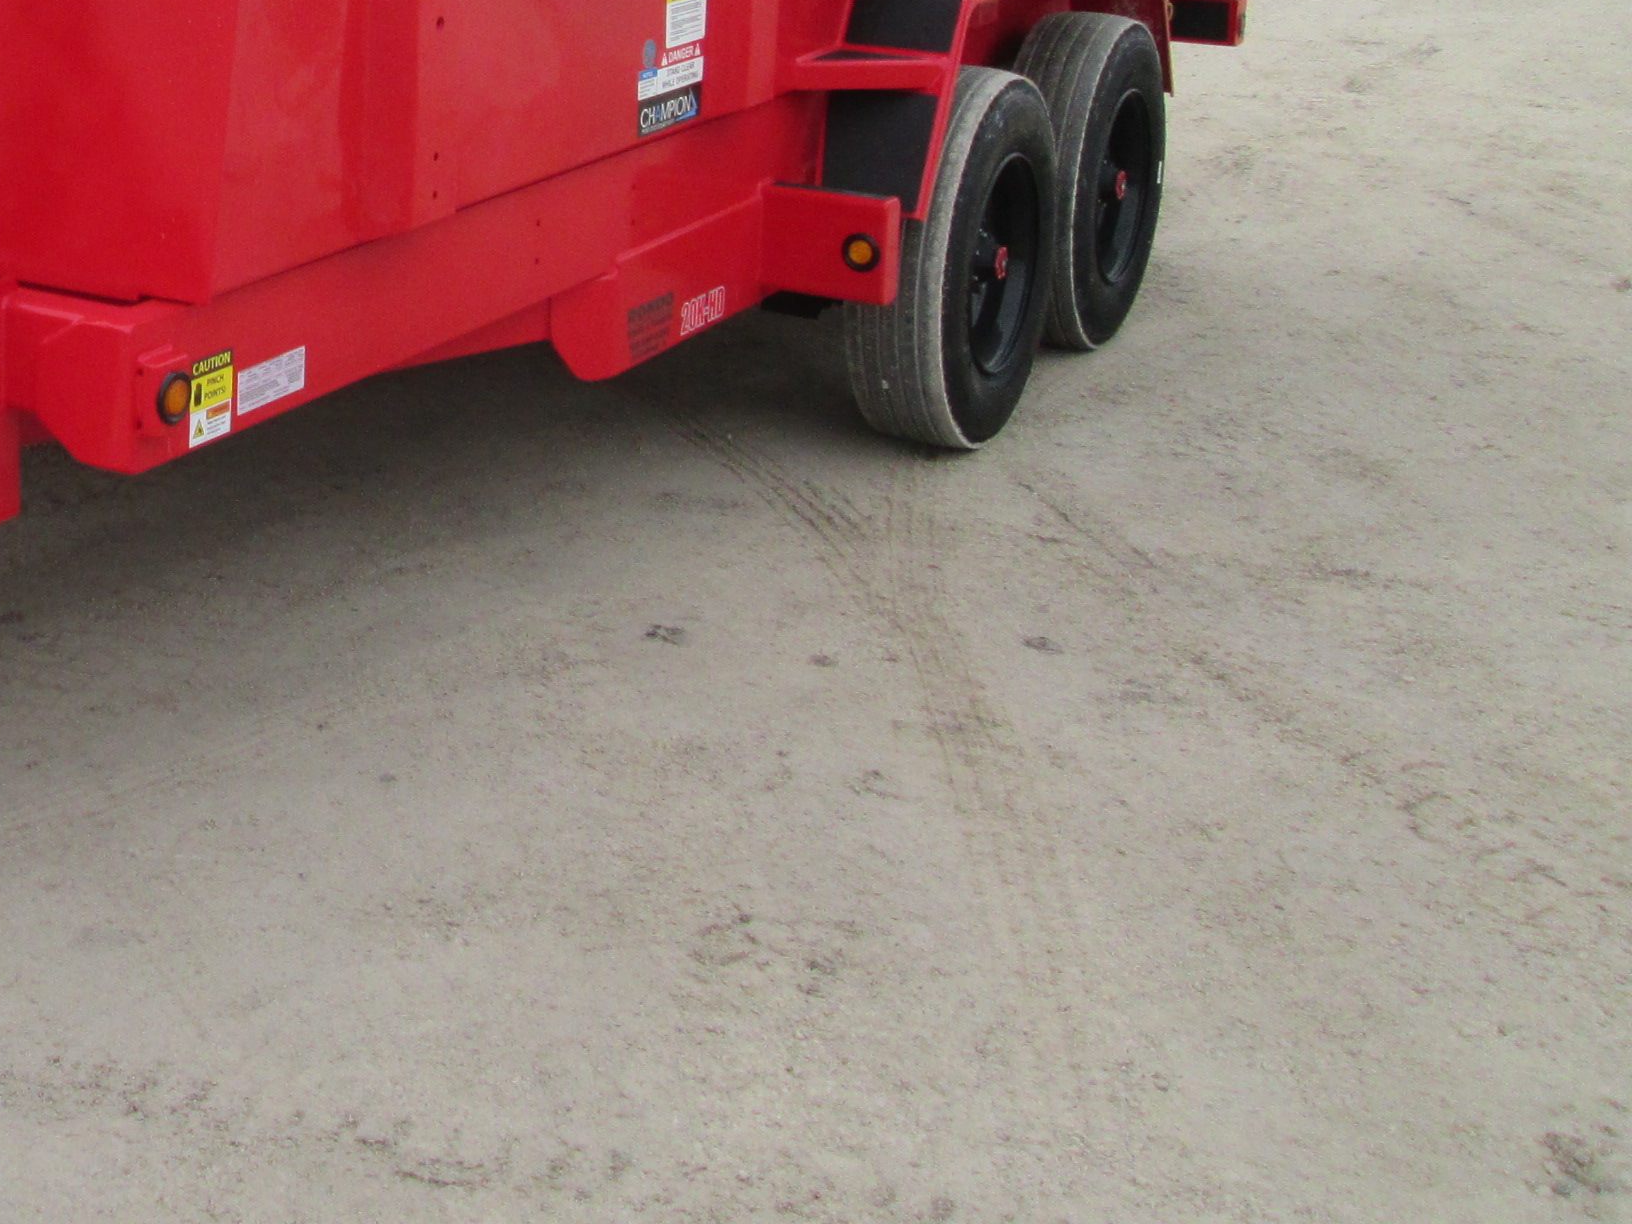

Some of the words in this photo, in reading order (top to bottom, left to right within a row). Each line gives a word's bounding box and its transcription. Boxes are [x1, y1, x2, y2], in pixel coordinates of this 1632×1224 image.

[668, 45, 694, 63] DANGER
[640, 94, 692, 128] CHAMPION
[680, 285, 725, 336] 20K-HD
[192, 350, 231, 376] CAUTION
[207, 374, 224, 386] PINCH
